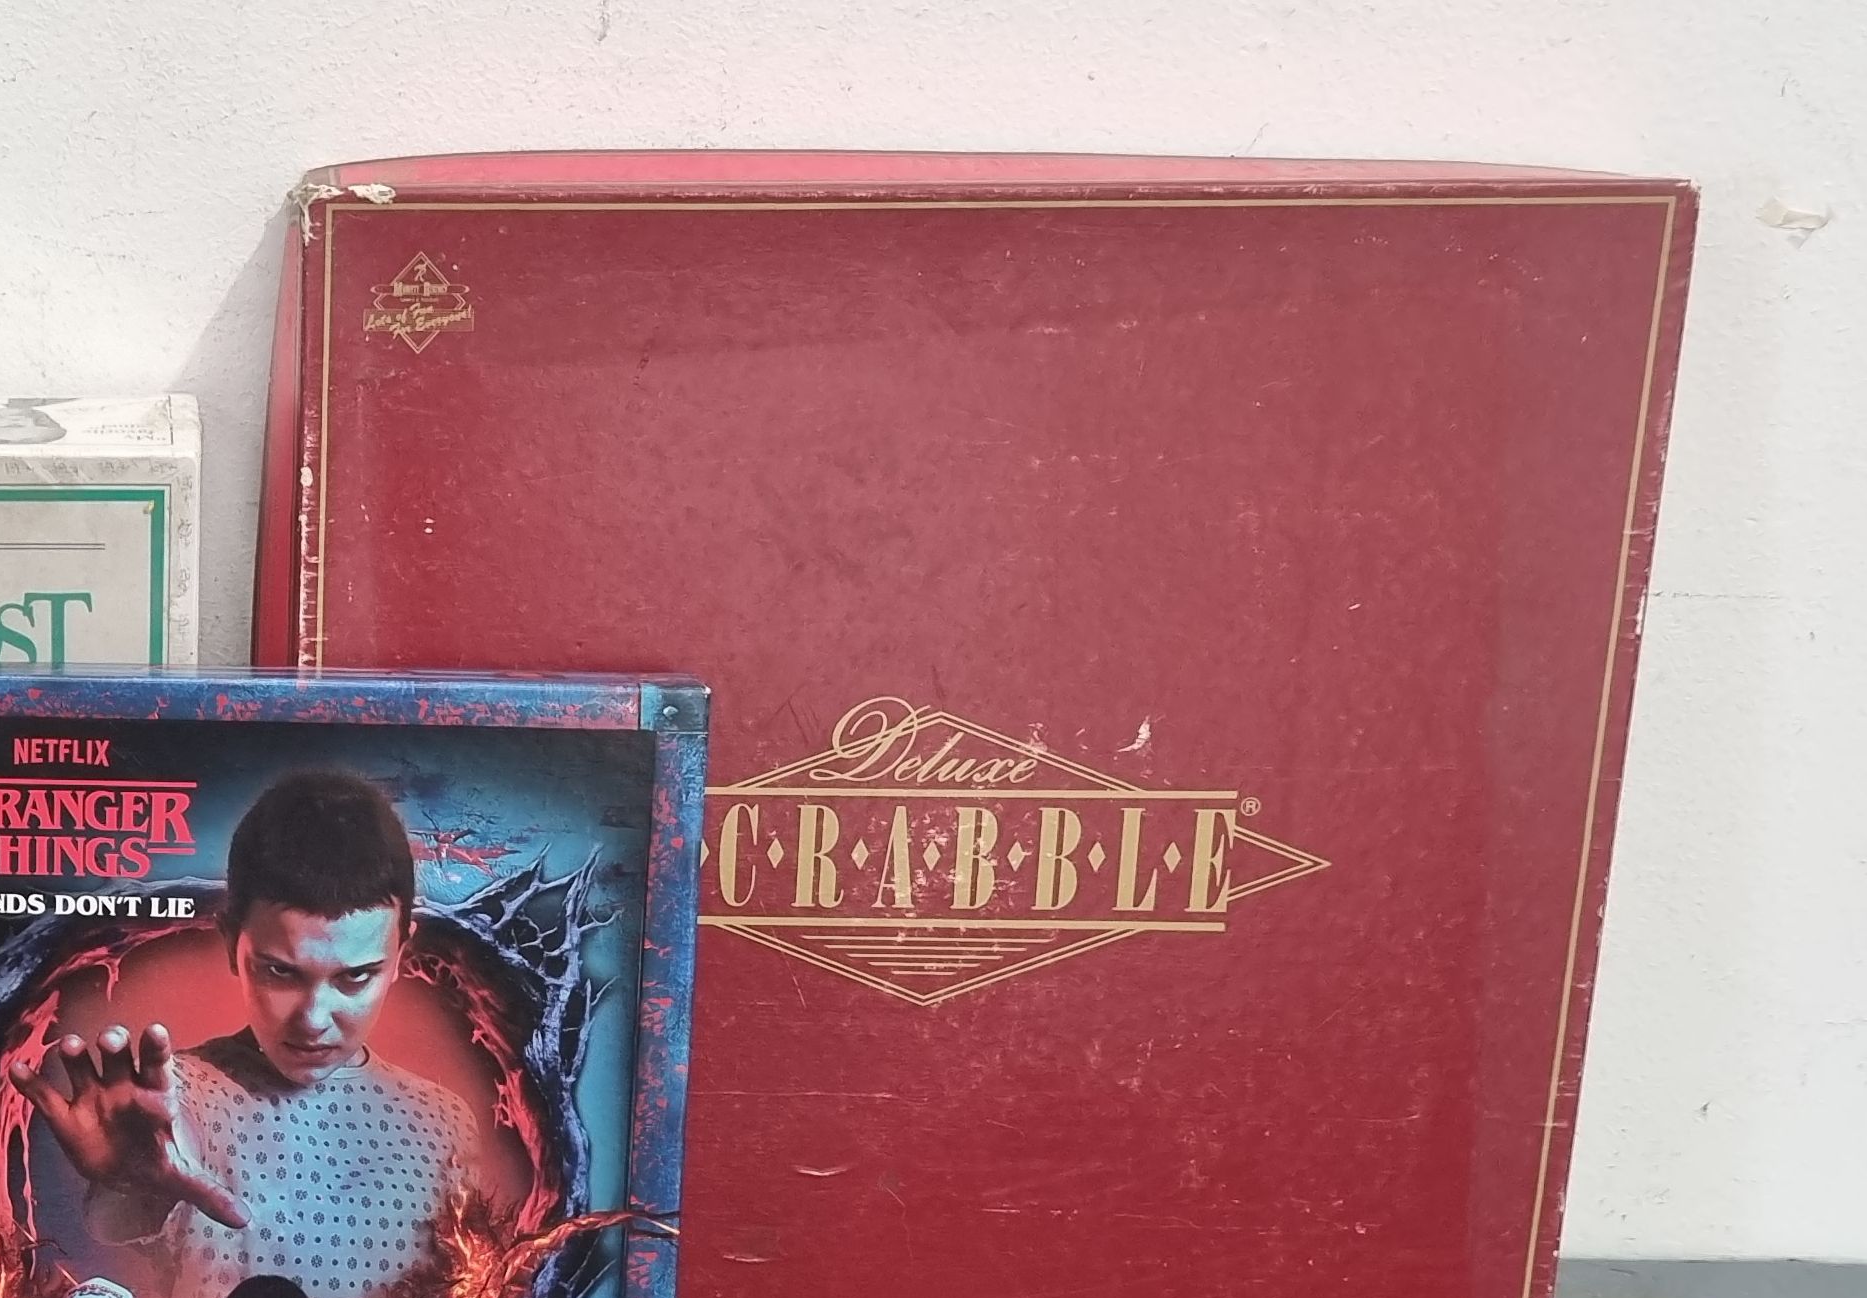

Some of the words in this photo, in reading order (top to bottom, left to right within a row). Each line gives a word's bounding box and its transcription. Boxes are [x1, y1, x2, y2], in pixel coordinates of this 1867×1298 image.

[13, 738, 110, 767] NETFLIX
[809, 696, 1038, 784] Deluxe
[54, 894, 142, 917] DON'T
[149, 897, 196, 919] LIE
